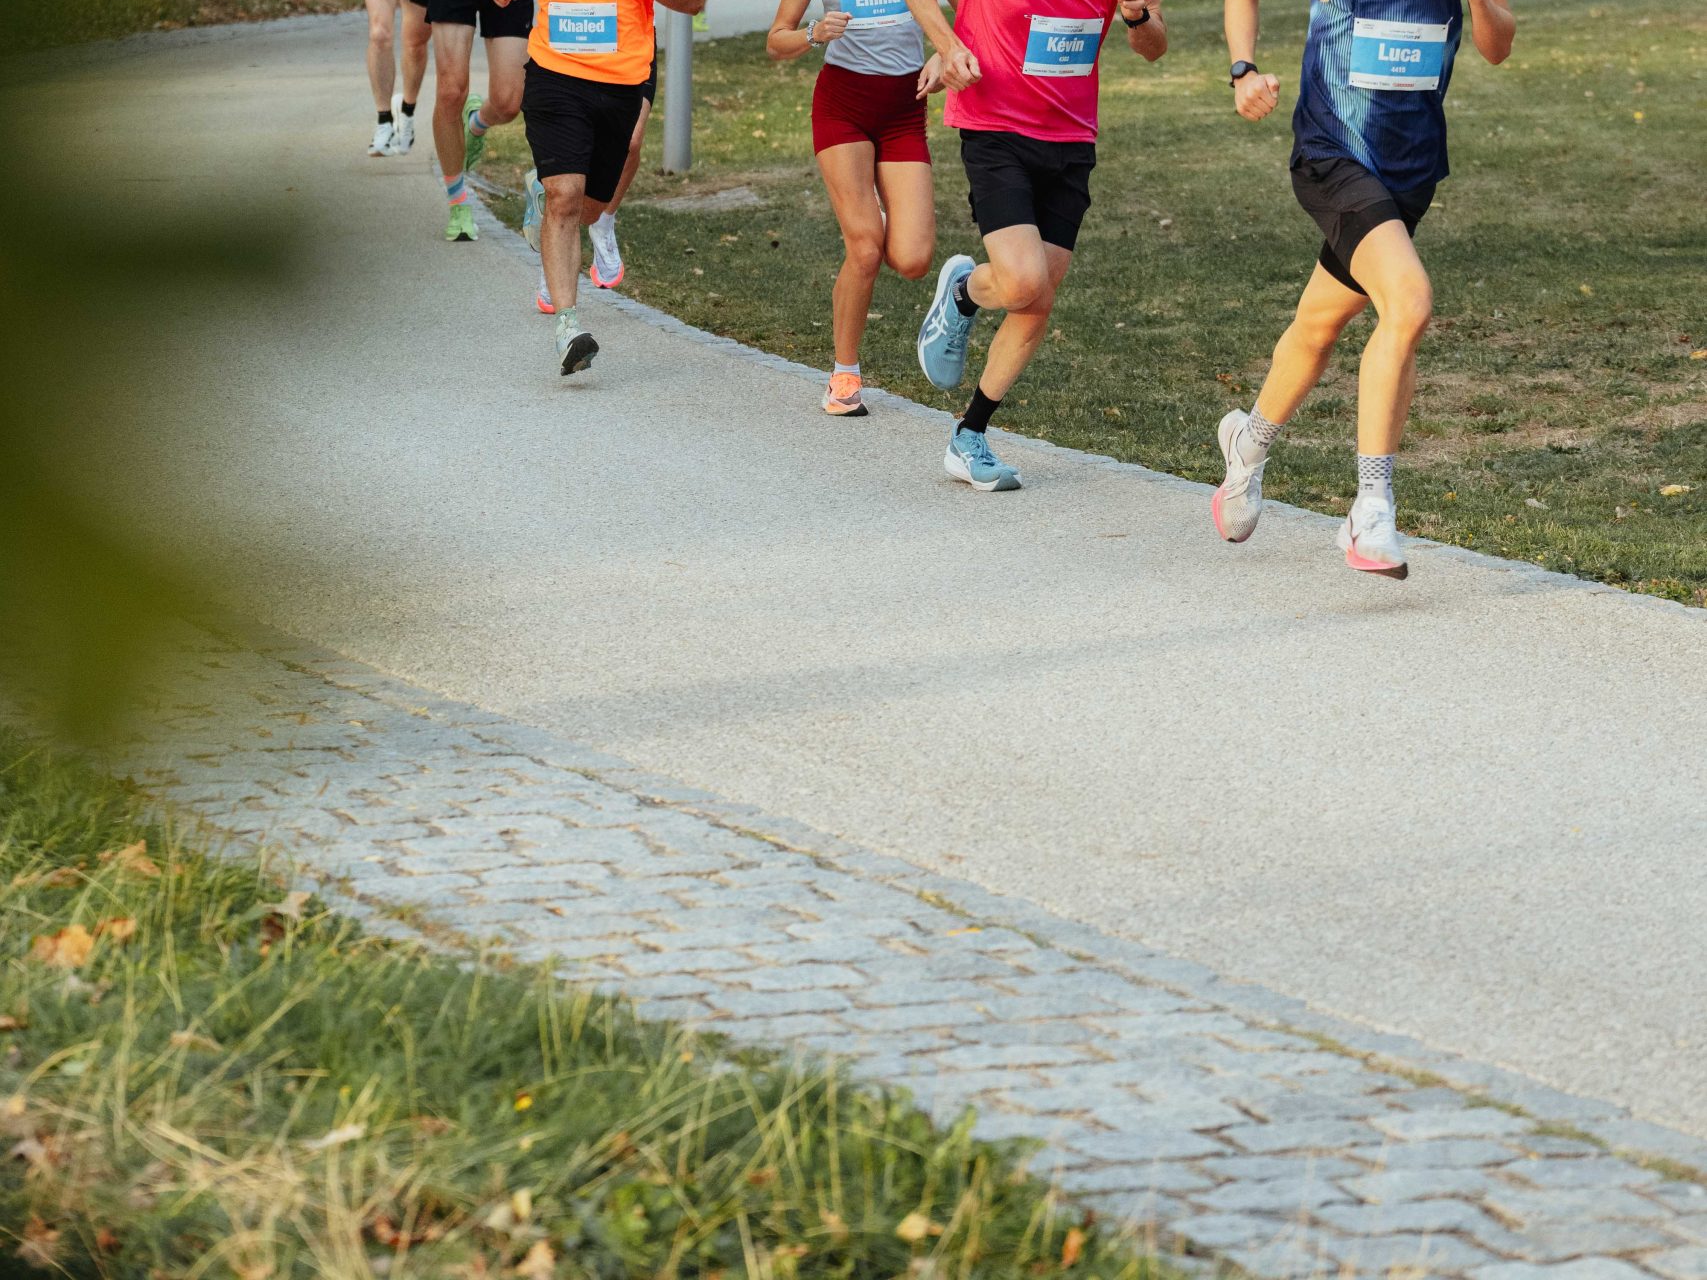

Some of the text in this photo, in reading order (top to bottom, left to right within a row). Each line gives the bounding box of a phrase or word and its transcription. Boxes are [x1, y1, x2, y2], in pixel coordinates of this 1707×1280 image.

[558, 18, 605, 33] Khaled
[1046, 36, 1085, 52] Kévin
[1378, 43, 1422, 63] Luca
